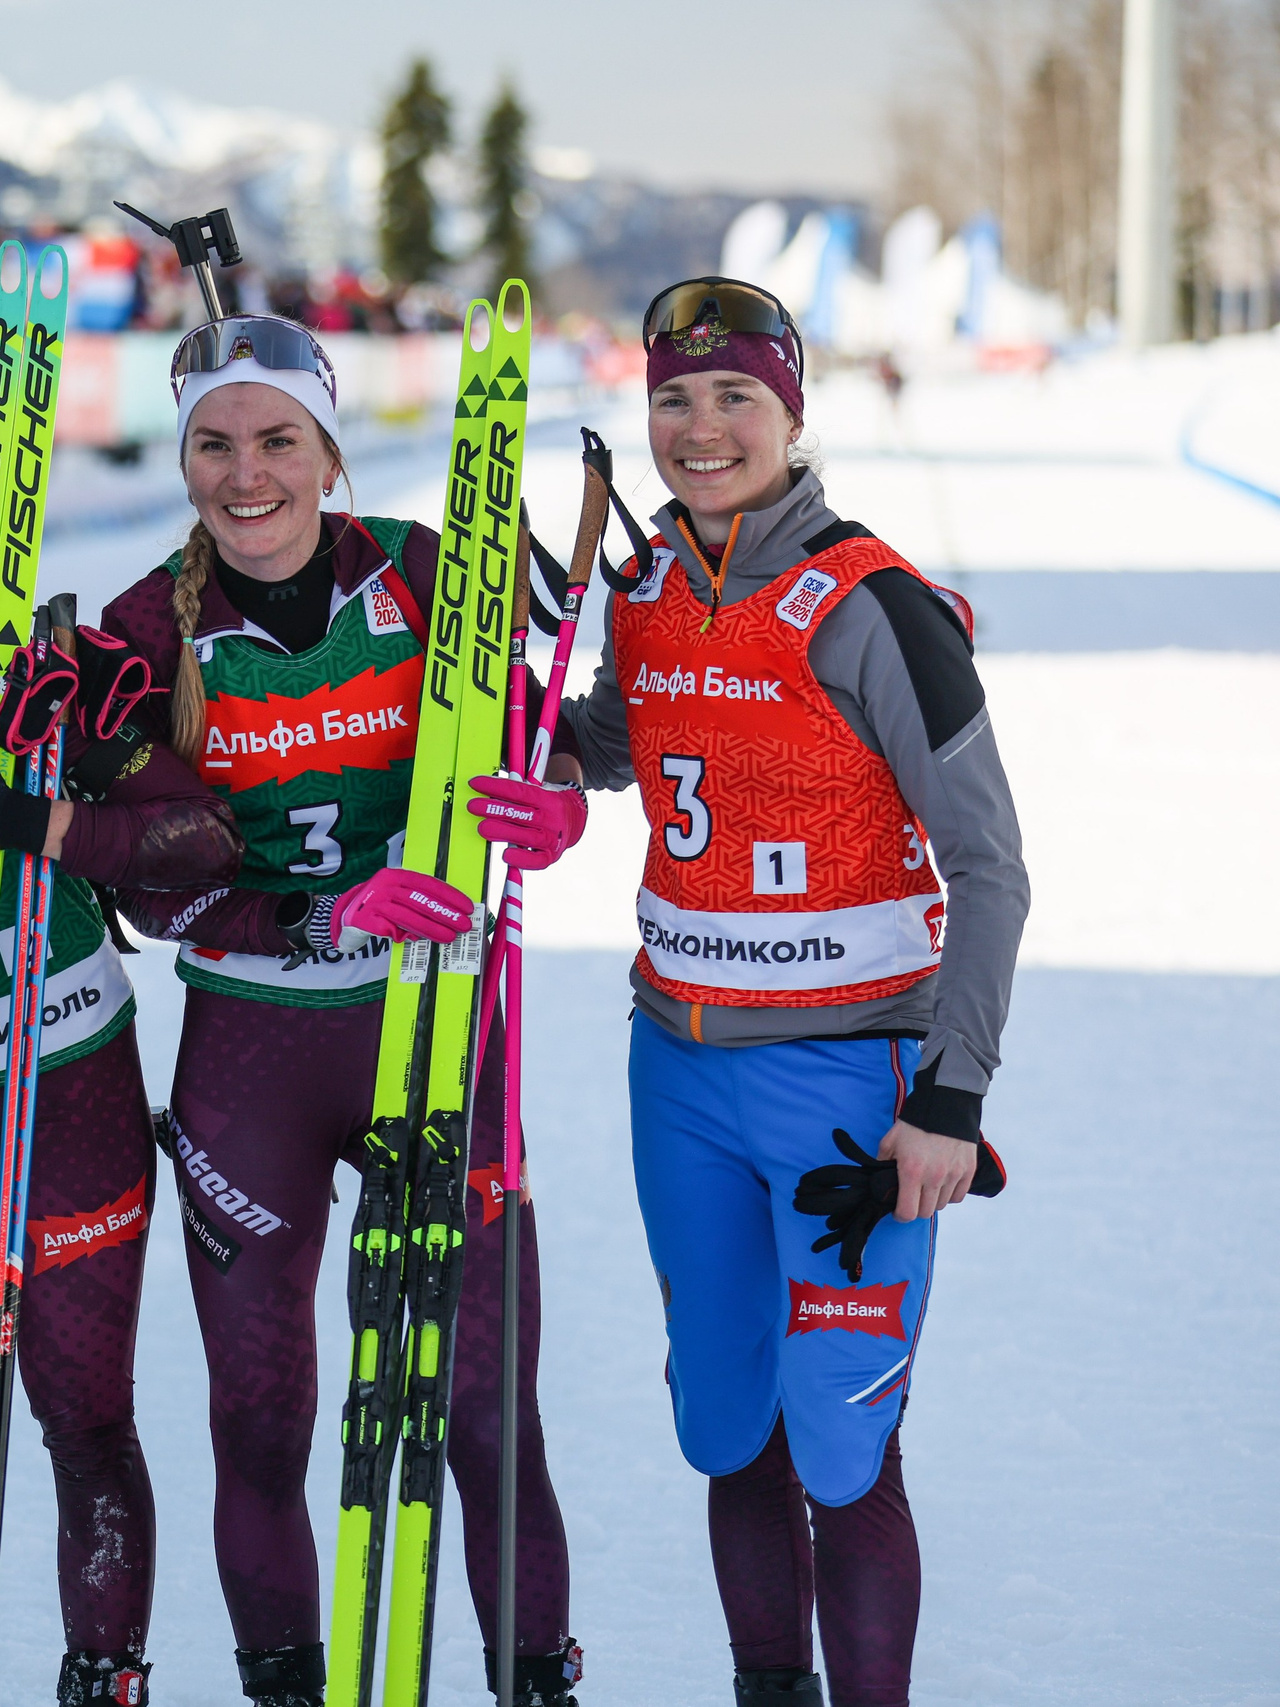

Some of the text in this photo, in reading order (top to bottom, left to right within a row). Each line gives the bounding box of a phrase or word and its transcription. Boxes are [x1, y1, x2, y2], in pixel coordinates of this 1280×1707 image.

[2, 322, 59, 601] FISCHER
[431, 438, 481, 712] FISCHER
[472, 421, 518, 700] FISCHER
[372, 594, 394, 611] 202
[781, 601, 811, 623] 2026
[631, 662, 783, 702] Альфа Банк
[206, 705, 408, 758] Альфа Банк
[661, 752, 712, 862] 3
[285, 800, 343, 879] 3
[768, 850, 783, 886] 1
[637, 918, 845, 965] ТЕХНОНИКОЛЬ
[43, 1205, 143, 1249] Альфа Банк
[798, 1300, 887, 1319] Альфа Банк
